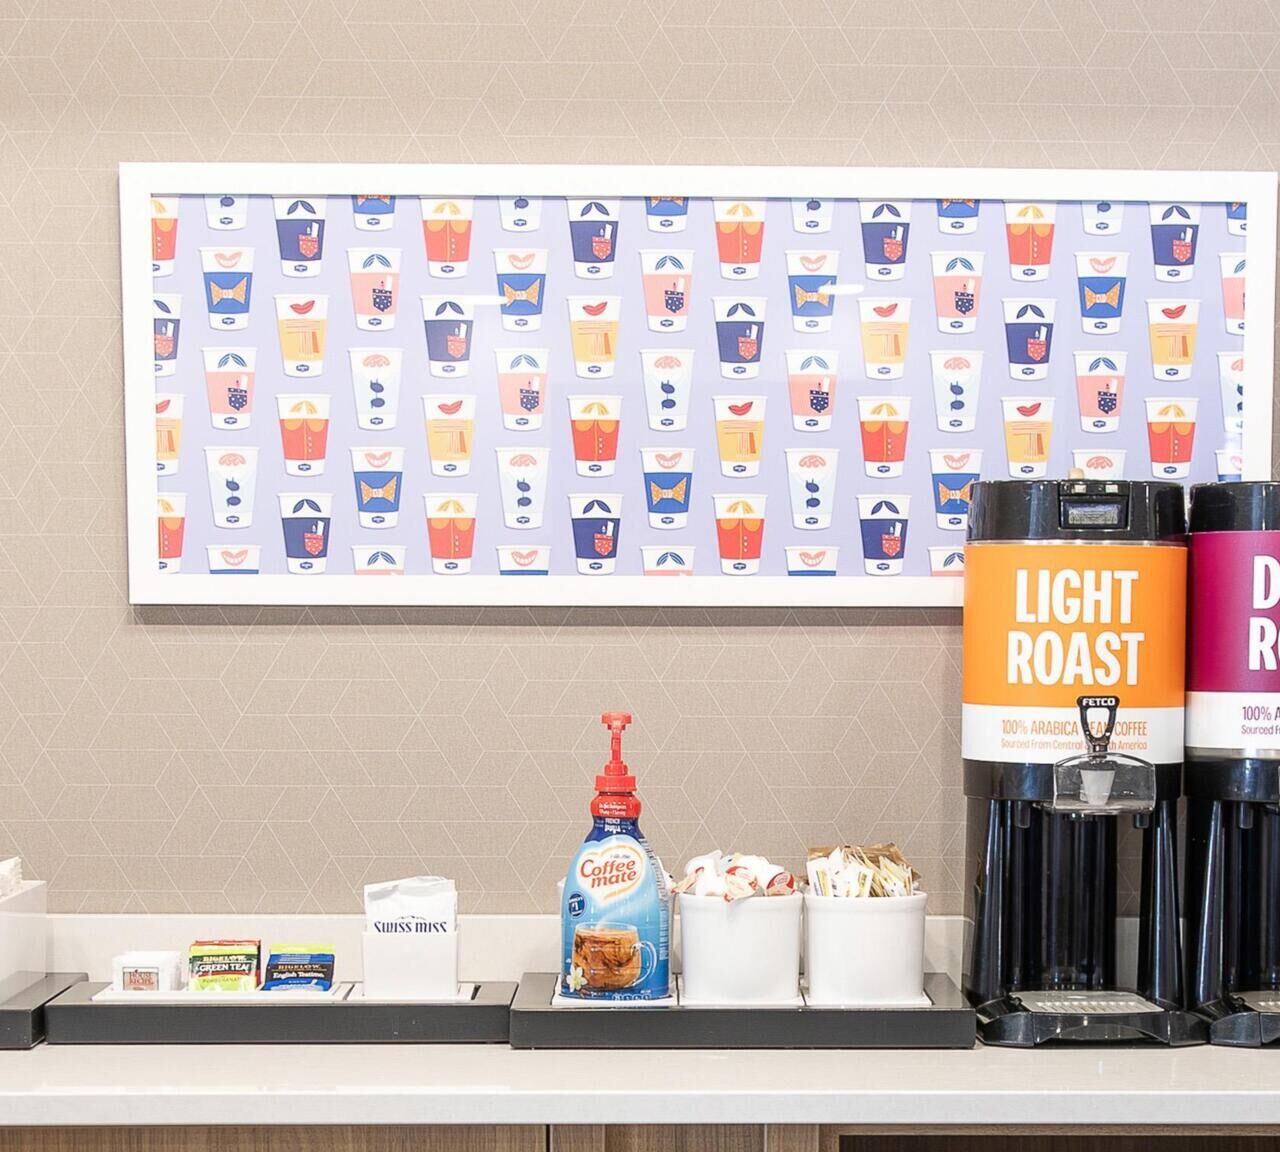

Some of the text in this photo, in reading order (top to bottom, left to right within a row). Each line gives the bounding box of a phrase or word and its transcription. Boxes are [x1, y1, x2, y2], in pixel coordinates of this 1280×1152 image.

[1015, 568, 1139, 624] LIGHT
[1007, 630, 1145, 686] ROAST
[1082, 697, 1116, 706] FETCO
[1242, 706, 1271, 721] 100%
[1002, 719, 1028, 735] 100%
[1030, 720, 1079, 736] ARABICA
[1114, 721, 1148, 737] COFFEE
[1241, 724, 1274, 736] Sourced
[1001, 738, 1030, 750] Sourced
[1031, 739, 1051, 750] From
[580, 859, 636, 878] Coffee
[591, 870, 637, 889] mate
[199, 963, 229, 972] GREEN
